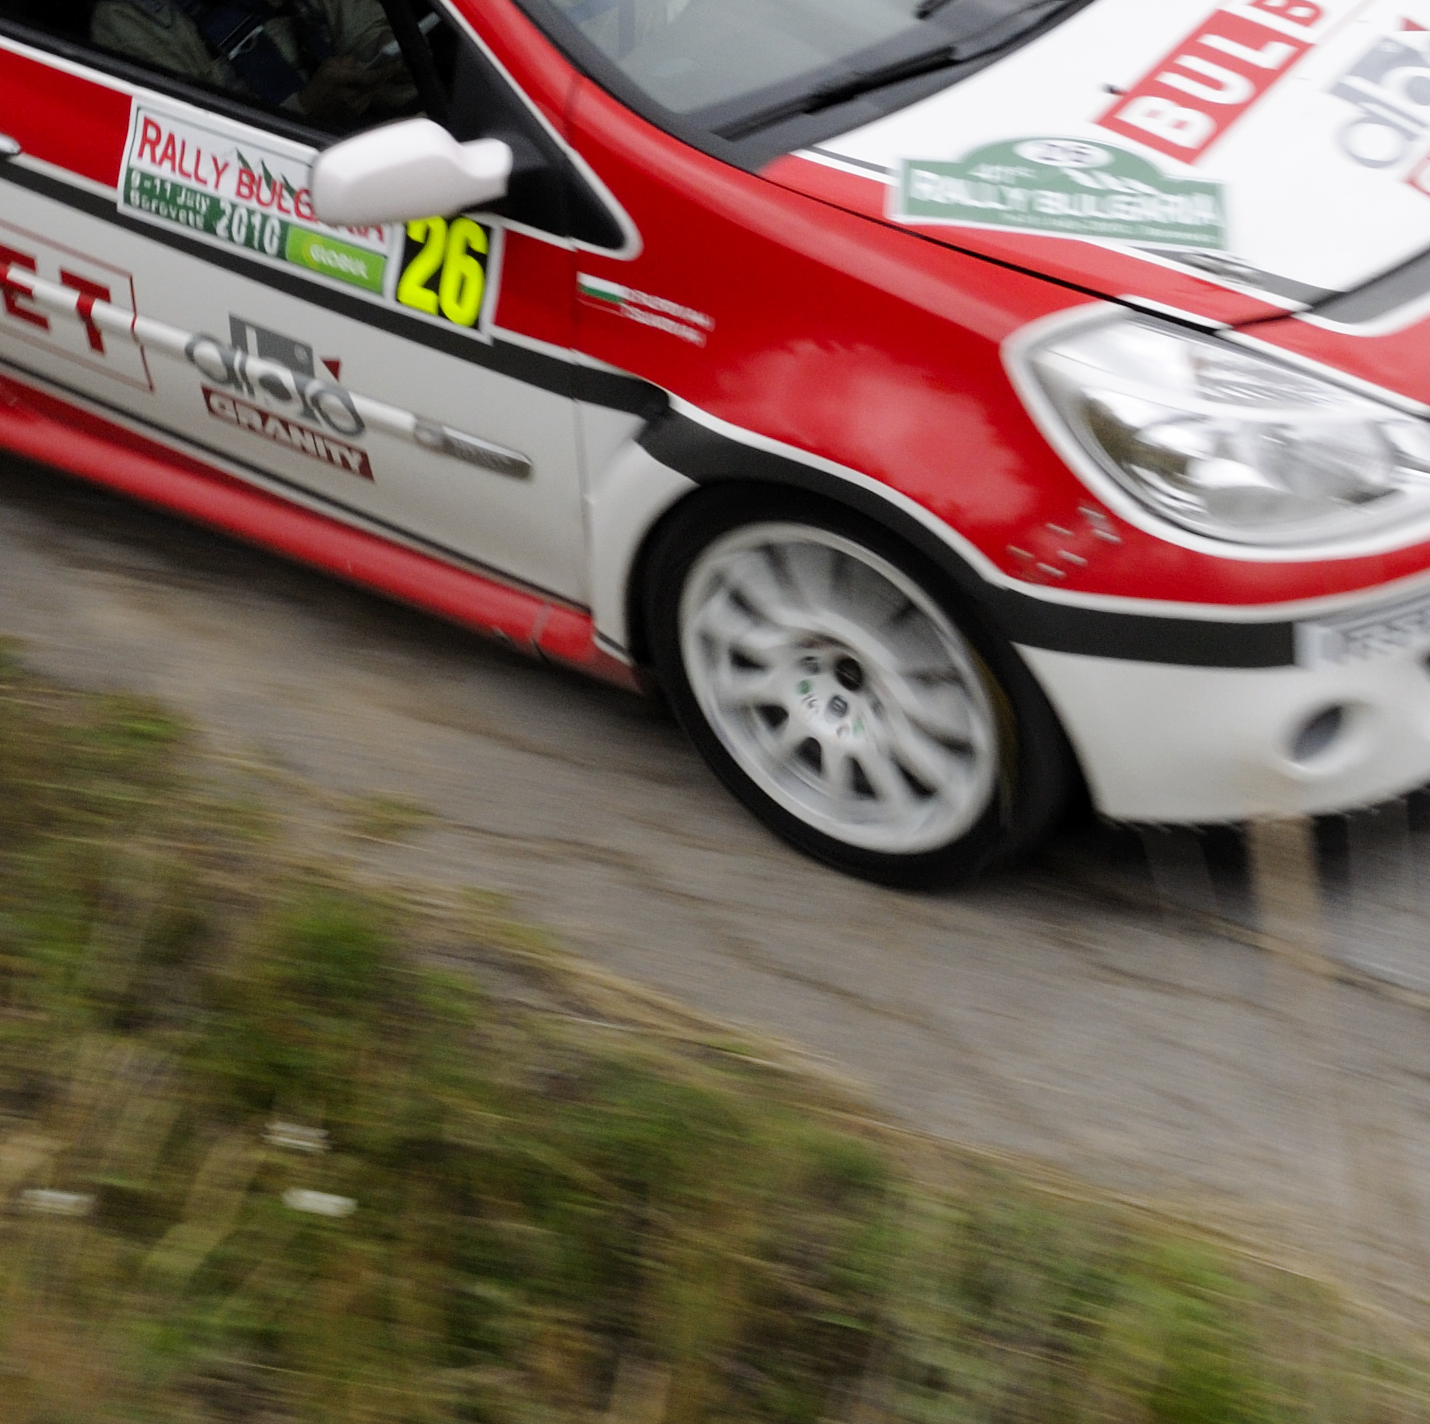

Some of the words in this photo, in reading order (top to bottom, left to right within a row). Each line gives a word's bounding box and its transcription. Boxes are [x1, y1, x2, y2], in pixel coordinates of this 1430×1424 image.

[137, 115, 230, 191] RALLY
[215, 199, 281, 257] 2010
[397, 215, 488, 327] 26
[208, 392, 364, 475] GRANITY
